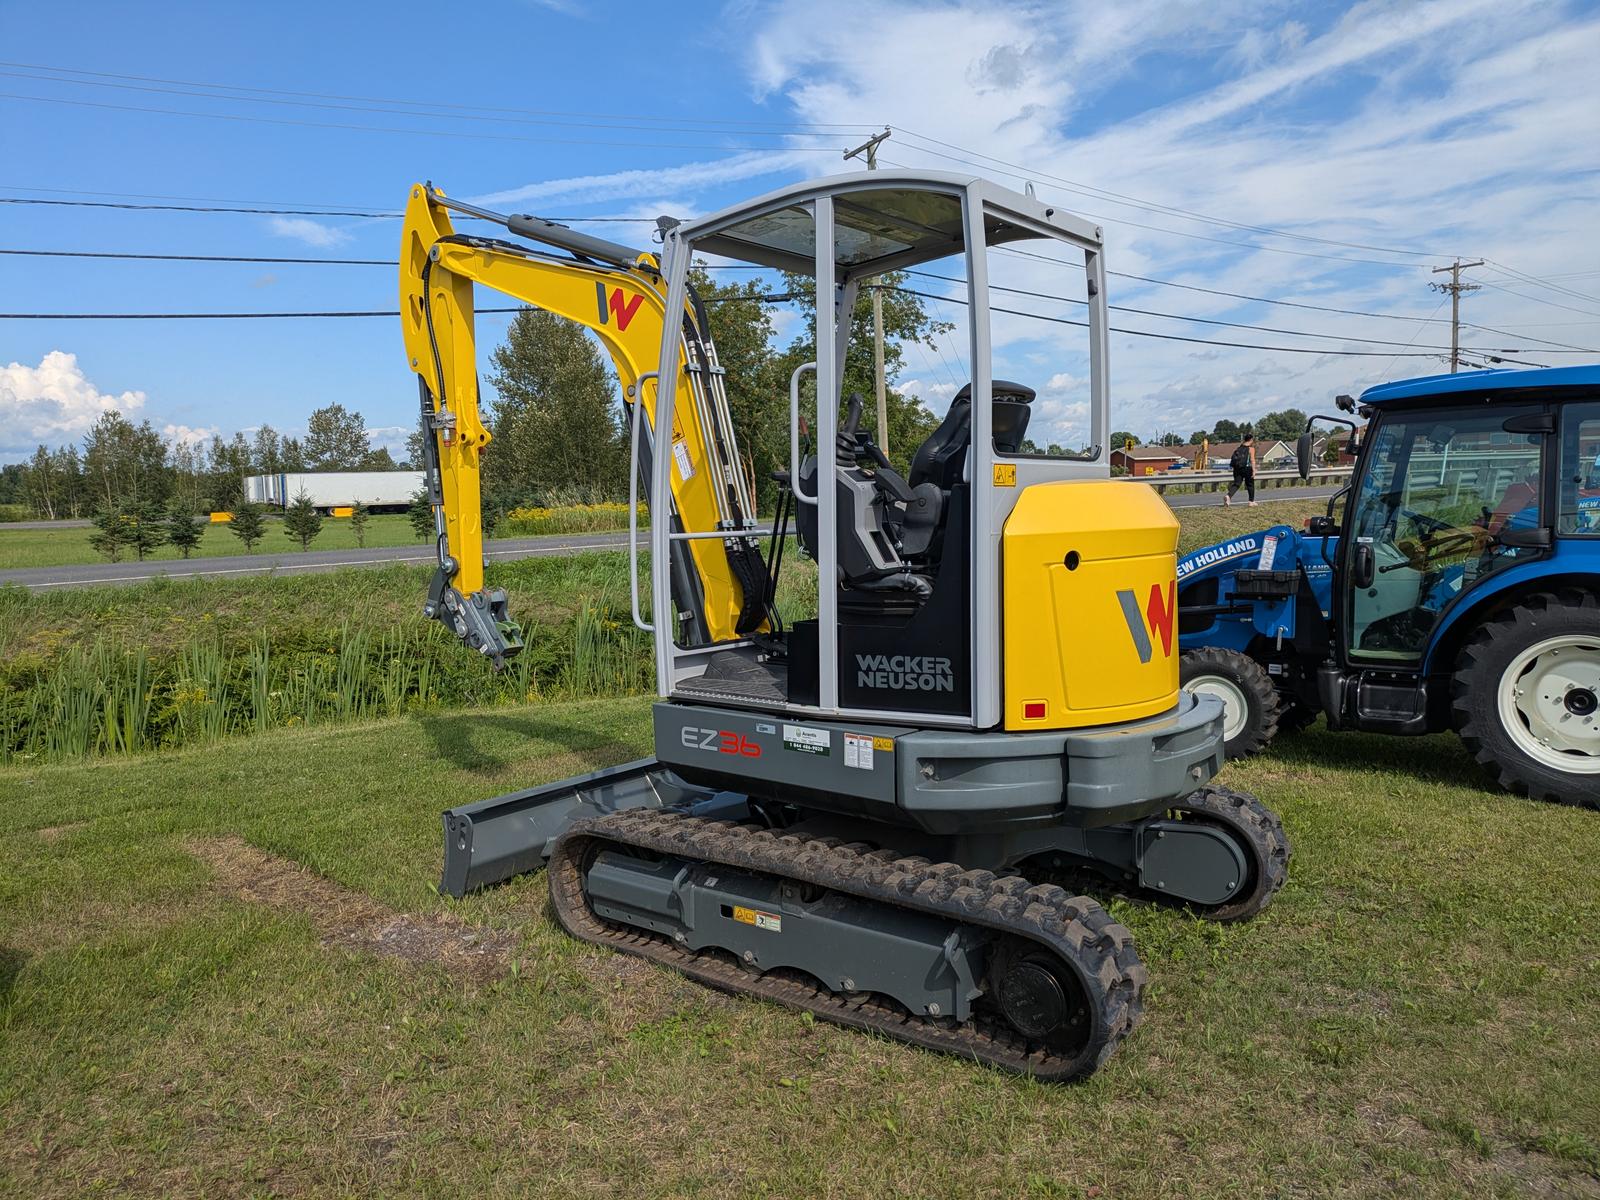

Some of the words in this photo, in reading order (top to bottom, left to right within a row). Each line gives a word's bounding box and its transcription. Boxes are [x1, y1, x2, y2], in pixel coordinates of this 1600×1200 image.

[1177, 559, 1194, 576] EW
[1195, 538, 1256, 568] HOLLAND
[855, 654, 953, 674] WACKER
[857, 671, 954, 692] NEUSON
[681, 726, 761, 758] EZ36
